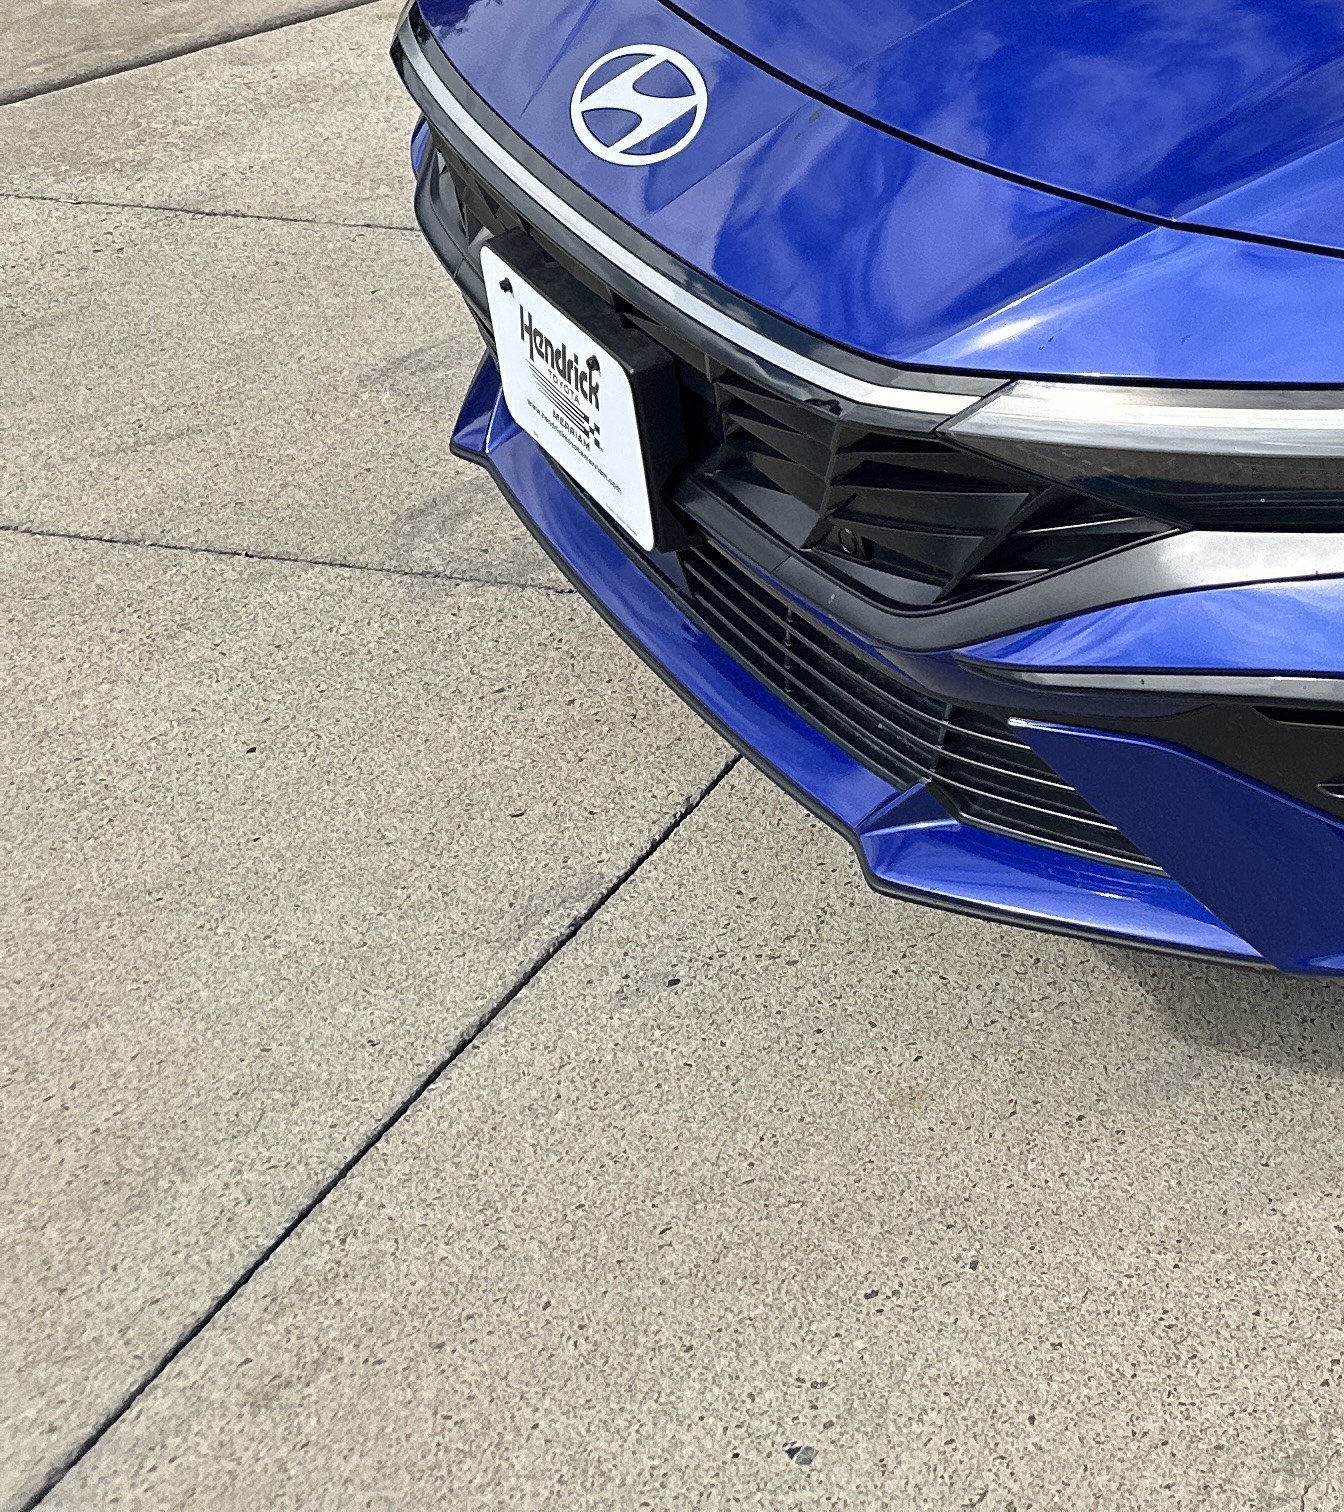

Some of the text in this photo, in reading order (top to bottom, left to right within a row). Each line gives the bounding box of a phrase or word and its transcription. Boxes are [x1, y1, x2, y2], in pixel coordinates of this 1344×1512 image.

[519, 303, 600, 412] Hendrick
[548, 369, 580, 405] TOYOTA
[552, 409, 590, 451] MERRIAM
